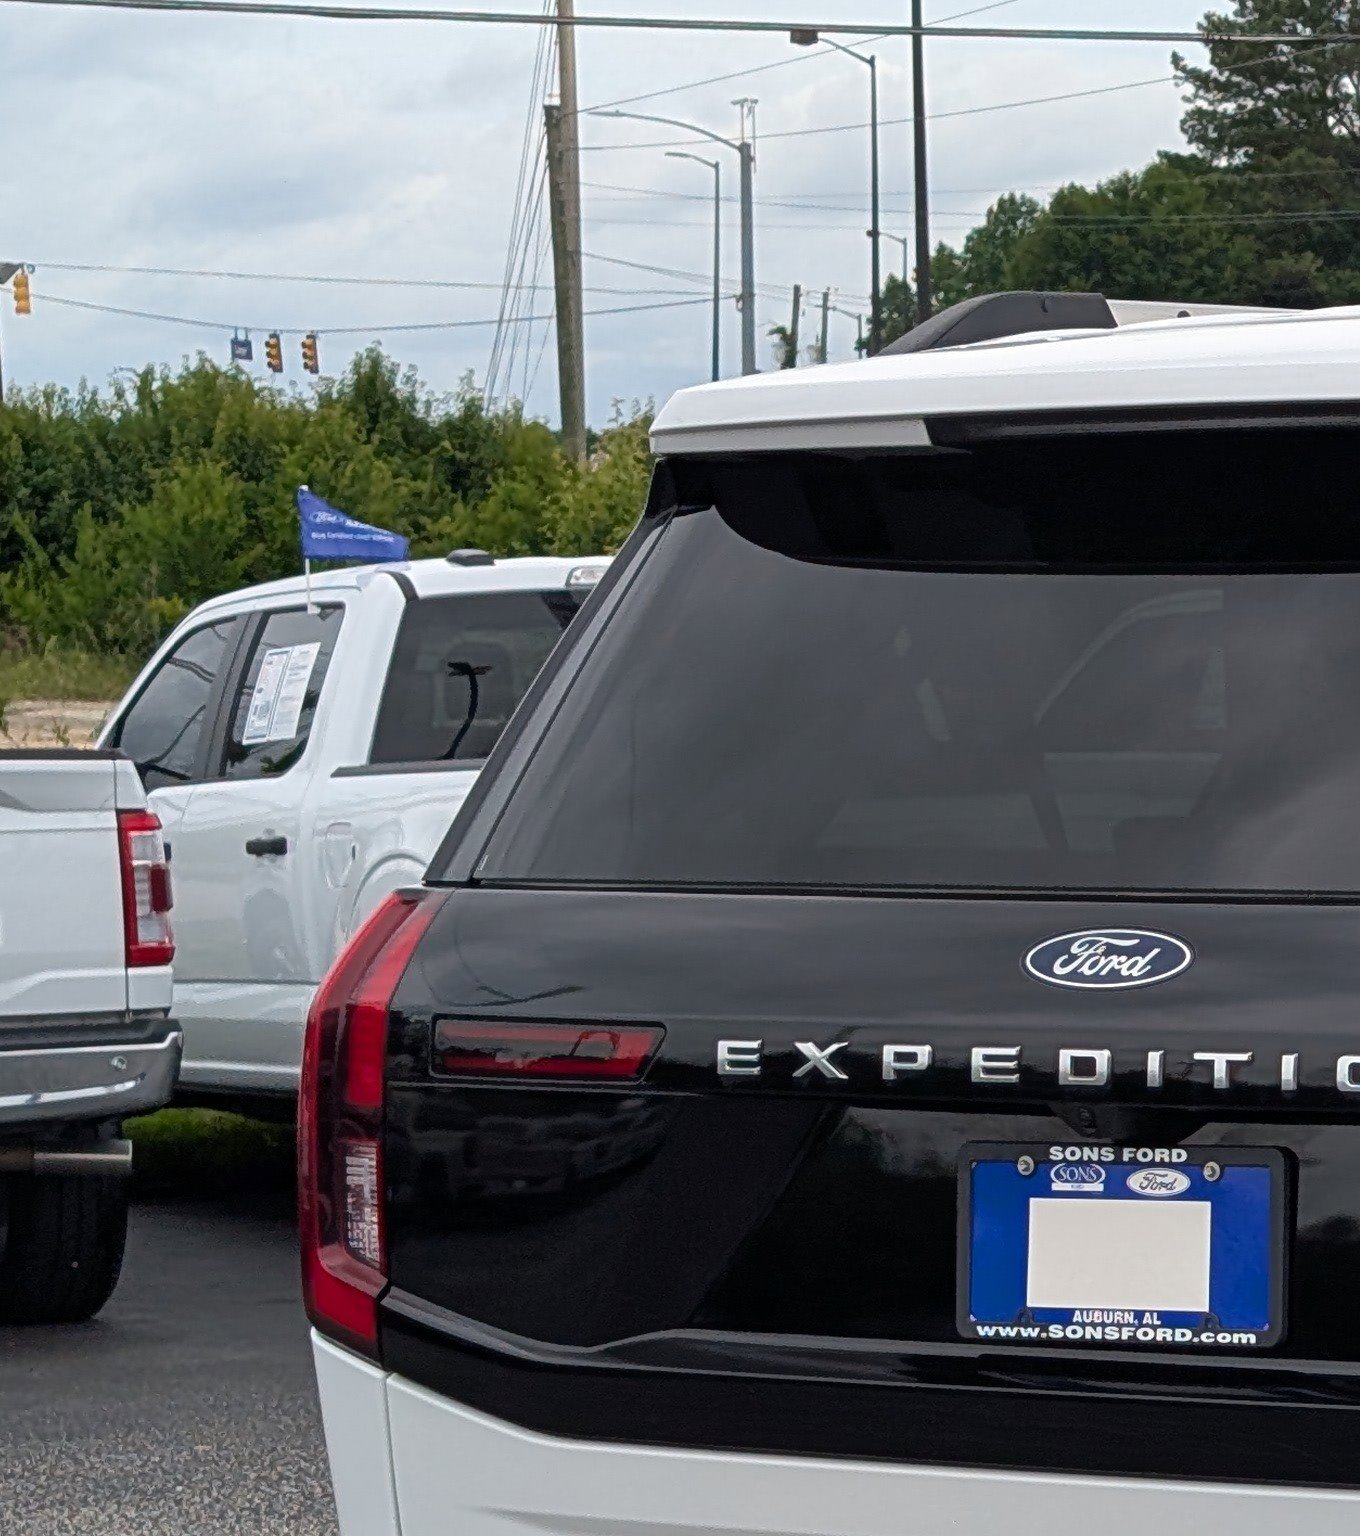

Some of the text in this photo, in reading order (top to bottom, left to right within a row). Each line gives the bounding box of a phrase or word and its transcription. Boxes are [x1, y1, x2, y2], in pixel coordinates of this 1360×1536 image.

[1053, 936, 1161, 977] Ford
[1049, 1146, 1188, 1163] SONS FORD
[1058, 1166, 1098, 1182] SONS
[1139, 1172, 1179, 1191] Ford
[1142, 1312, 1162, 1325] AL
[976, 1324, 1257, 1344] www.SONSFORD.com
